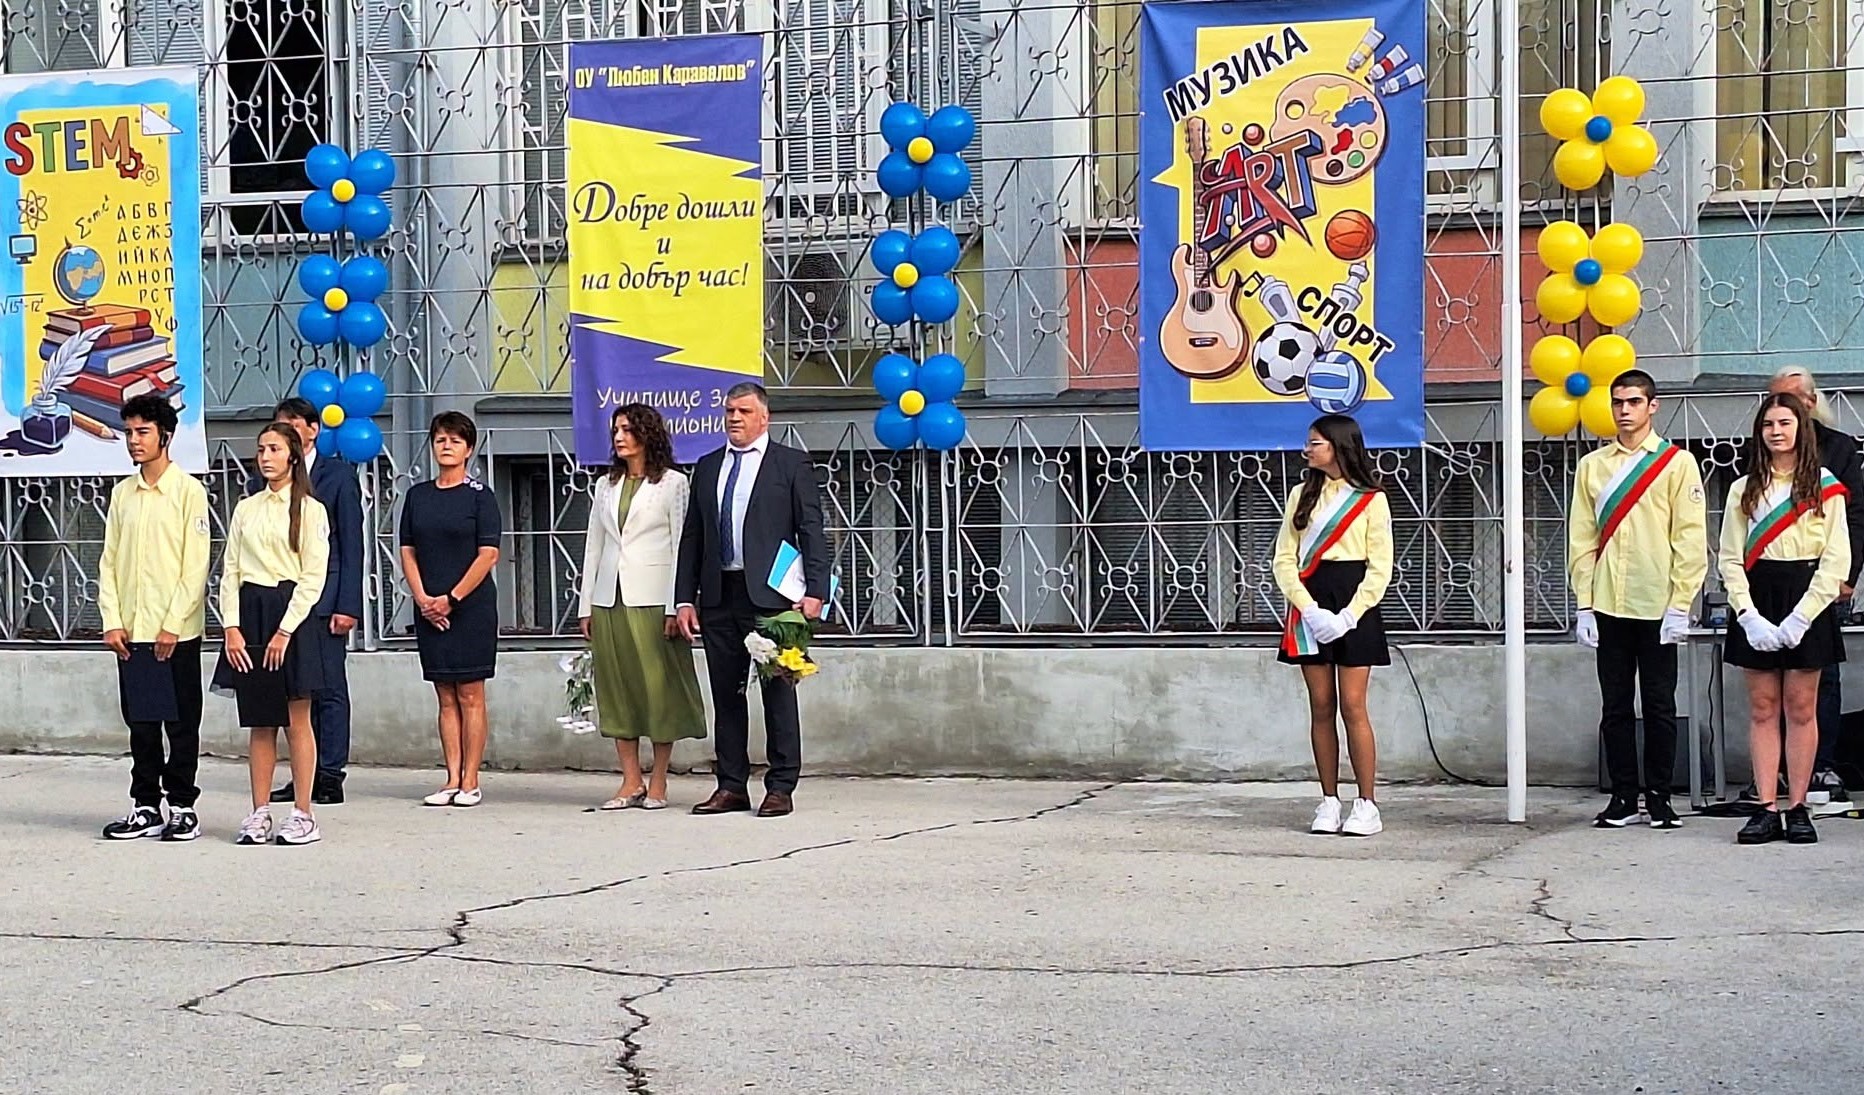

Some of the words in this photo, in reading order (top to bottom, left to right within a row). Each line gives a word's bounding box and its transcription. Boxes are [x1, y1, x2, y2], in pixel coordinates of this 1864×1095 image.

[574, 67, 595, 89] ОУ
[598, 65, 660, 88] "Любен
[1165, 26, 1308, 122] МУЗИКА
[4, 116, 131, 176] STEM
[573, 181, 669, 230] Добре
[677, 192, 756, 221] дошли
[1199, 129, 1328, 249] ART
[656, 237, 671, 255] и
[581, 271, 611, 290] на
[618, 261, 690, 297] добър
[698, 262, 749, 287] час!
[1297, 286, 1393, 363] СПОРТ
[597, 386, 701, 415] Училище
